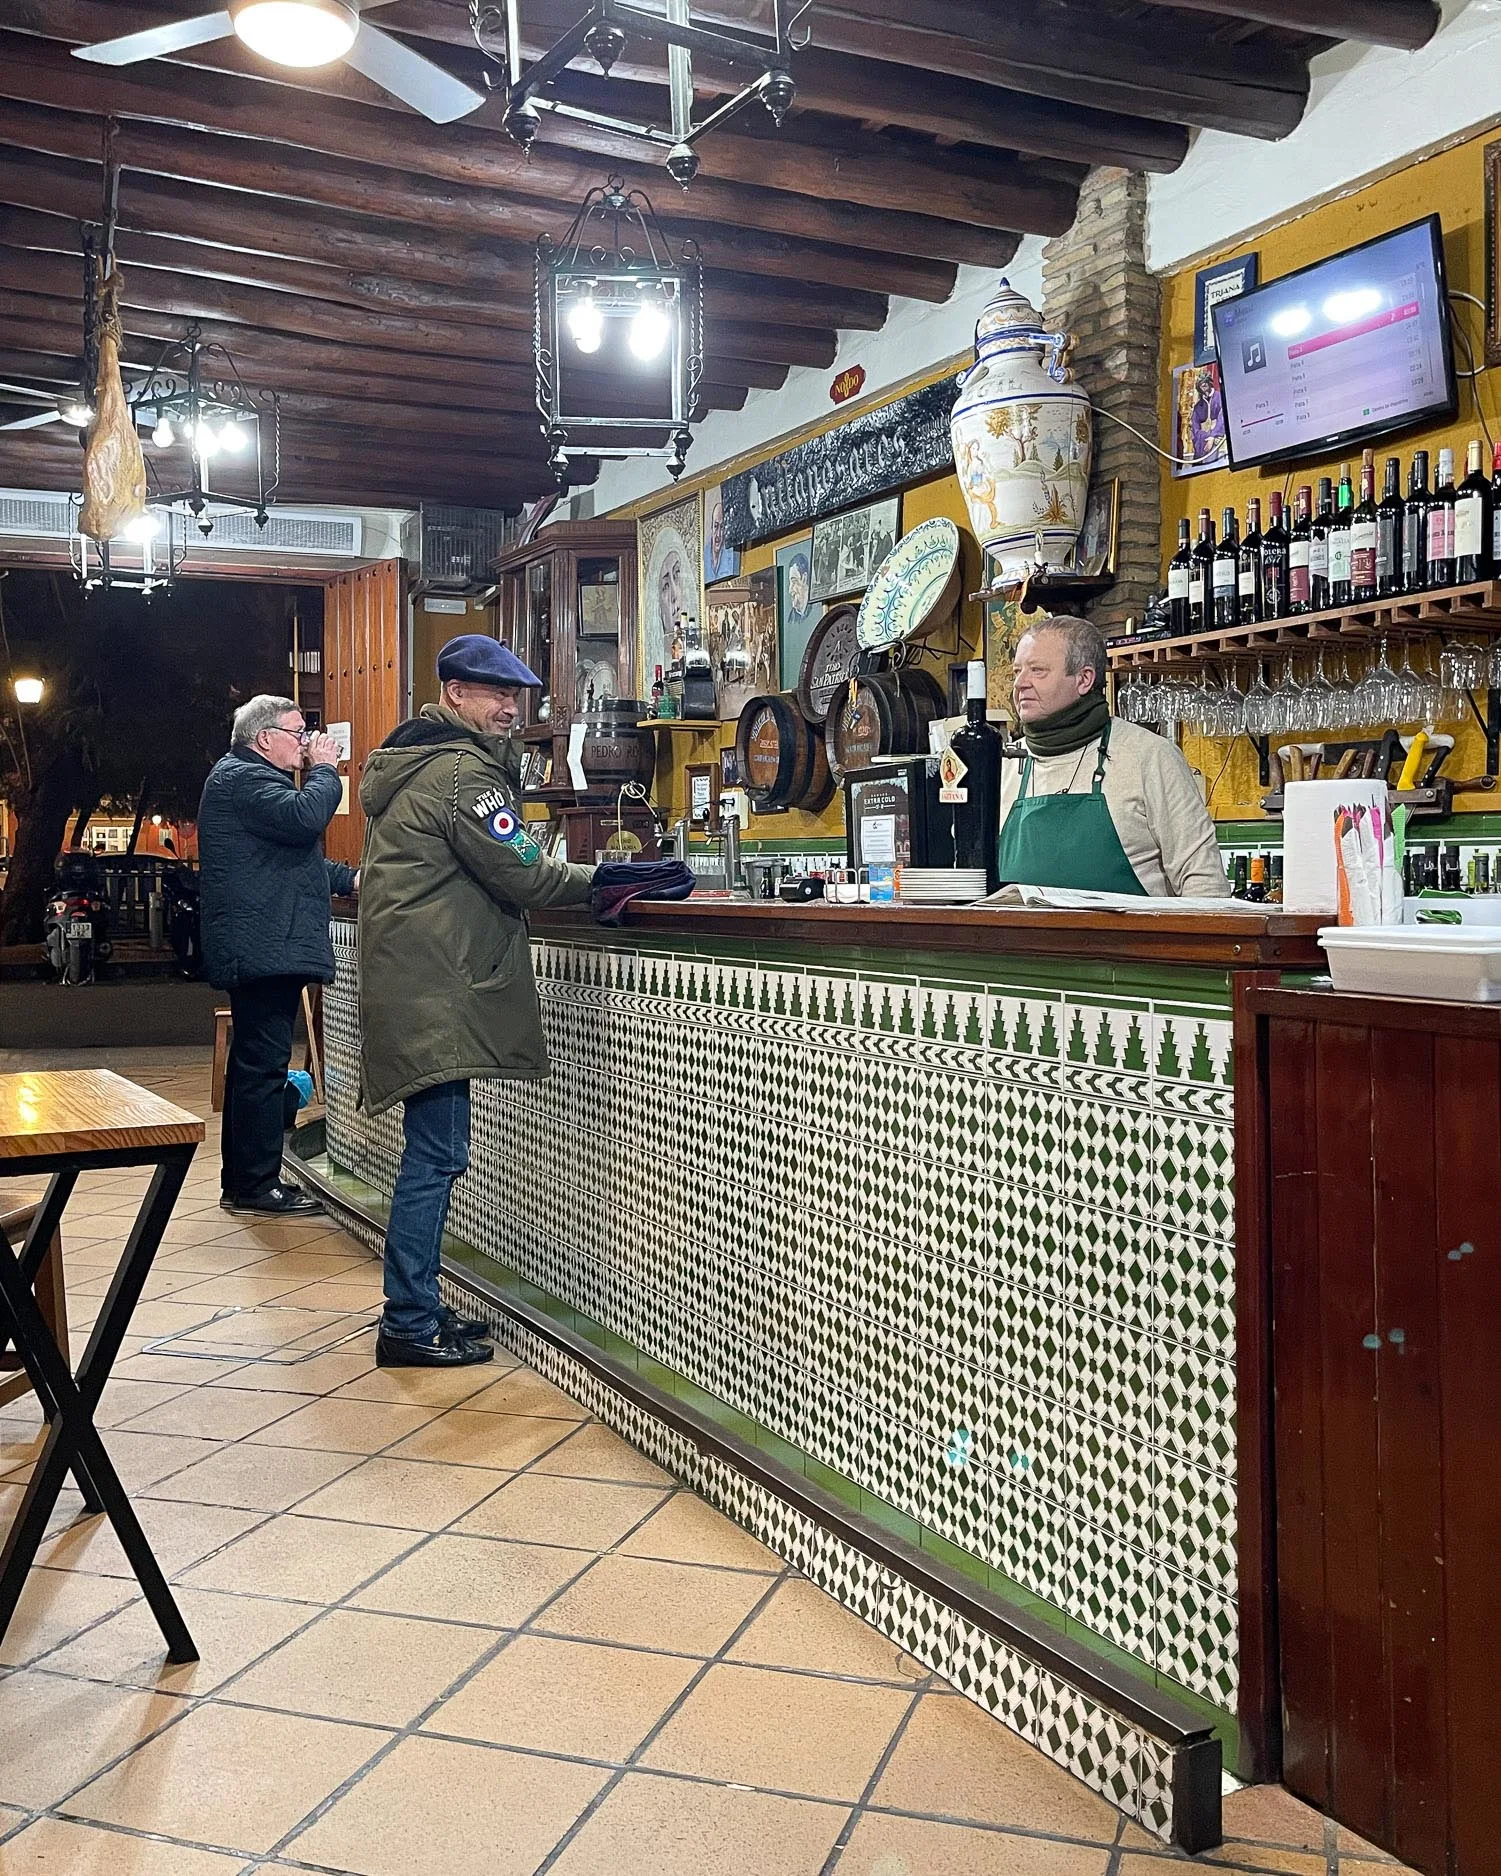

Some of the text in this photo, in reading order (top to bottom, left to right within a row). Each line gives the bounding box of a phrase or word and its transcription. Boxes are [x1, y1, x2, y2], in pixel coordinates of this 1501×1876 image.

[1210, 284, 1240, 299] TRIANA
[591, 745, 622, 758] PEDRO
[471, 787, 505, 818] WHO
[475, 790, 491, 802] THE
[863, 796, 880, 805] EXTRA
[881, 795, 896, 803] COLD
